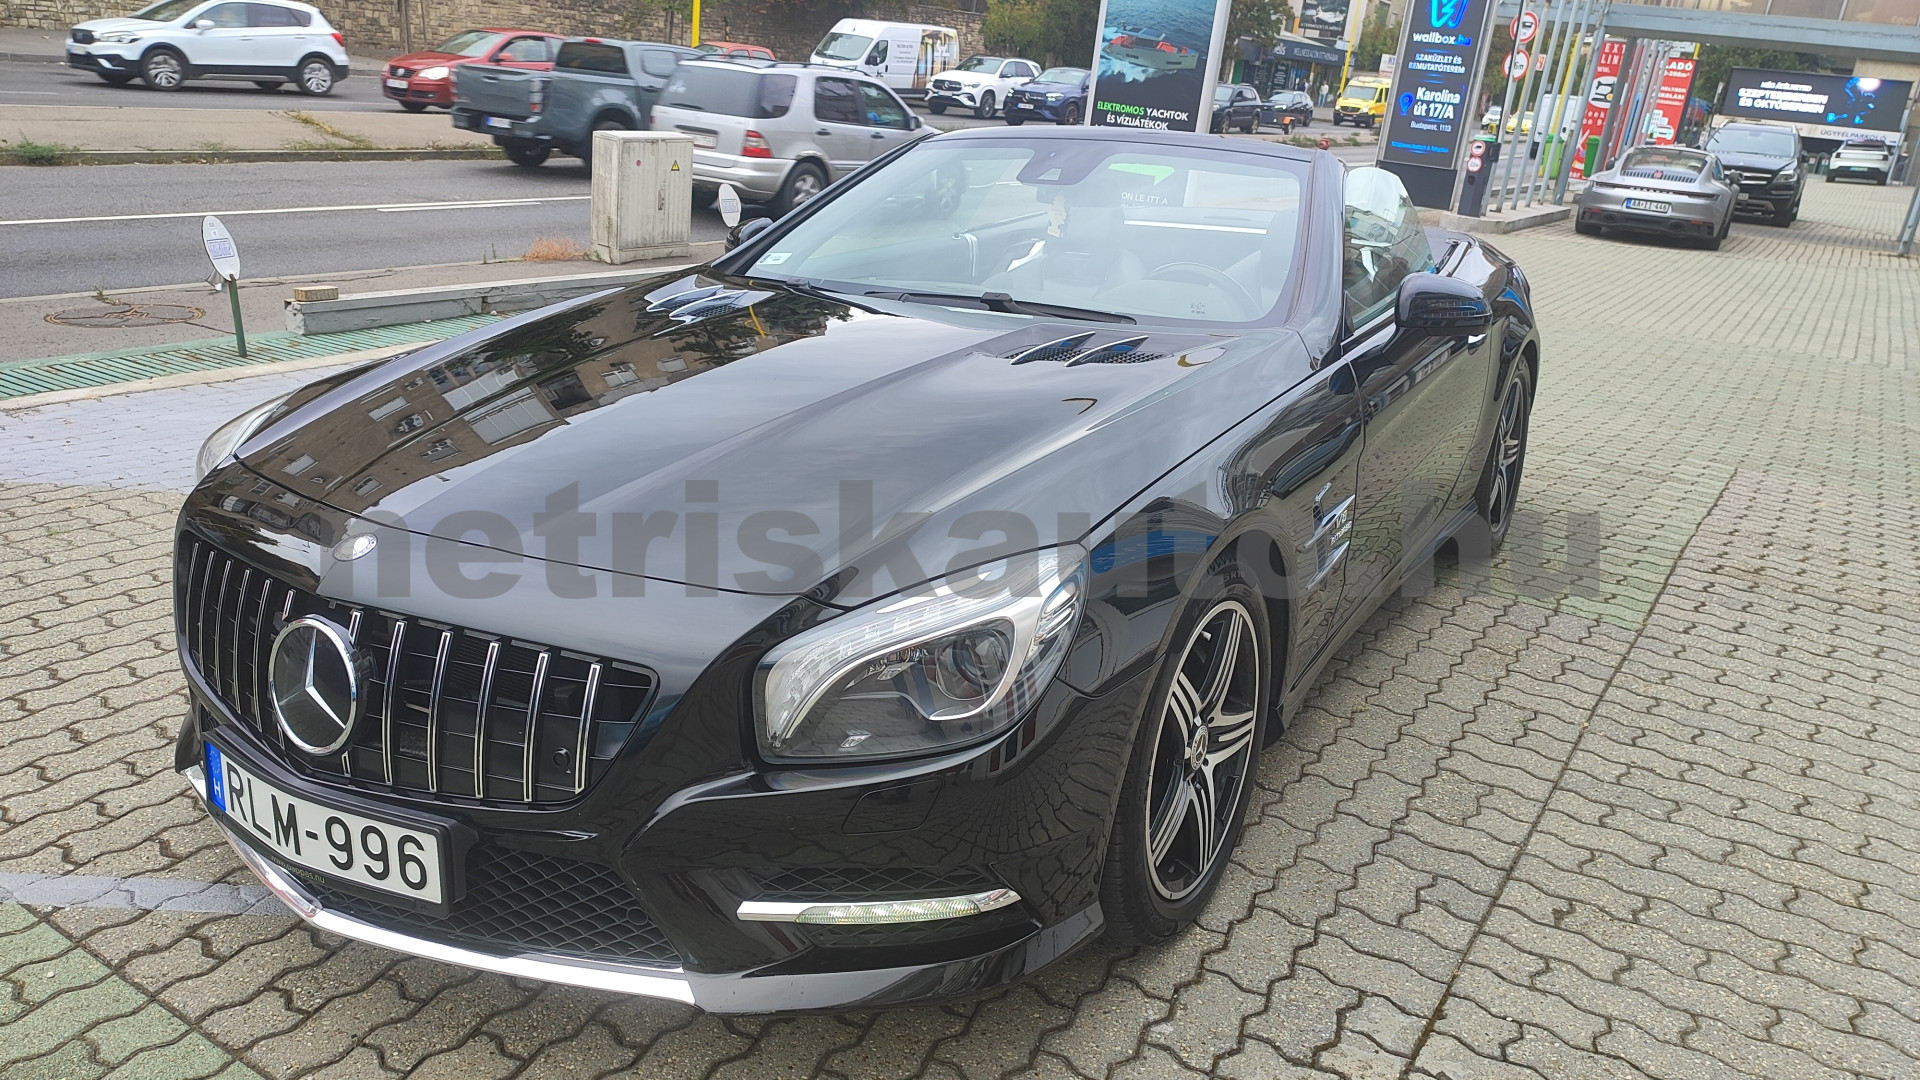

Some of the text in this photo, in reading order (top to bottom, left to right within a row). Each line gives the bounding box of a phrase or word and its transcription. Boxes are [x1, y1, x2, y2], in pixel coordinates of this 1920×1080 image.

[1412, 31, 1472, 46] wallbox.hu
[1415, 53, 1462, 64] SZAKÜZLET ÉS
[1408, 62, 1465, 74] BEMUTATÓTEREM
[1416, 86, 1460, 104] Karolina
[1097, 101, 1189, 121] ELEKTROMOS YACHTOK
[1413, 101, 1454, 119] út 17/A
[1106, 113, 1169, 131] ÉS VÍZIJÁTÉKOK
[1121, 191, 1168, 205] ON LE ITT A
[213, 778, 222, 799] H
[226, 760, 428, 891] RLM-996
